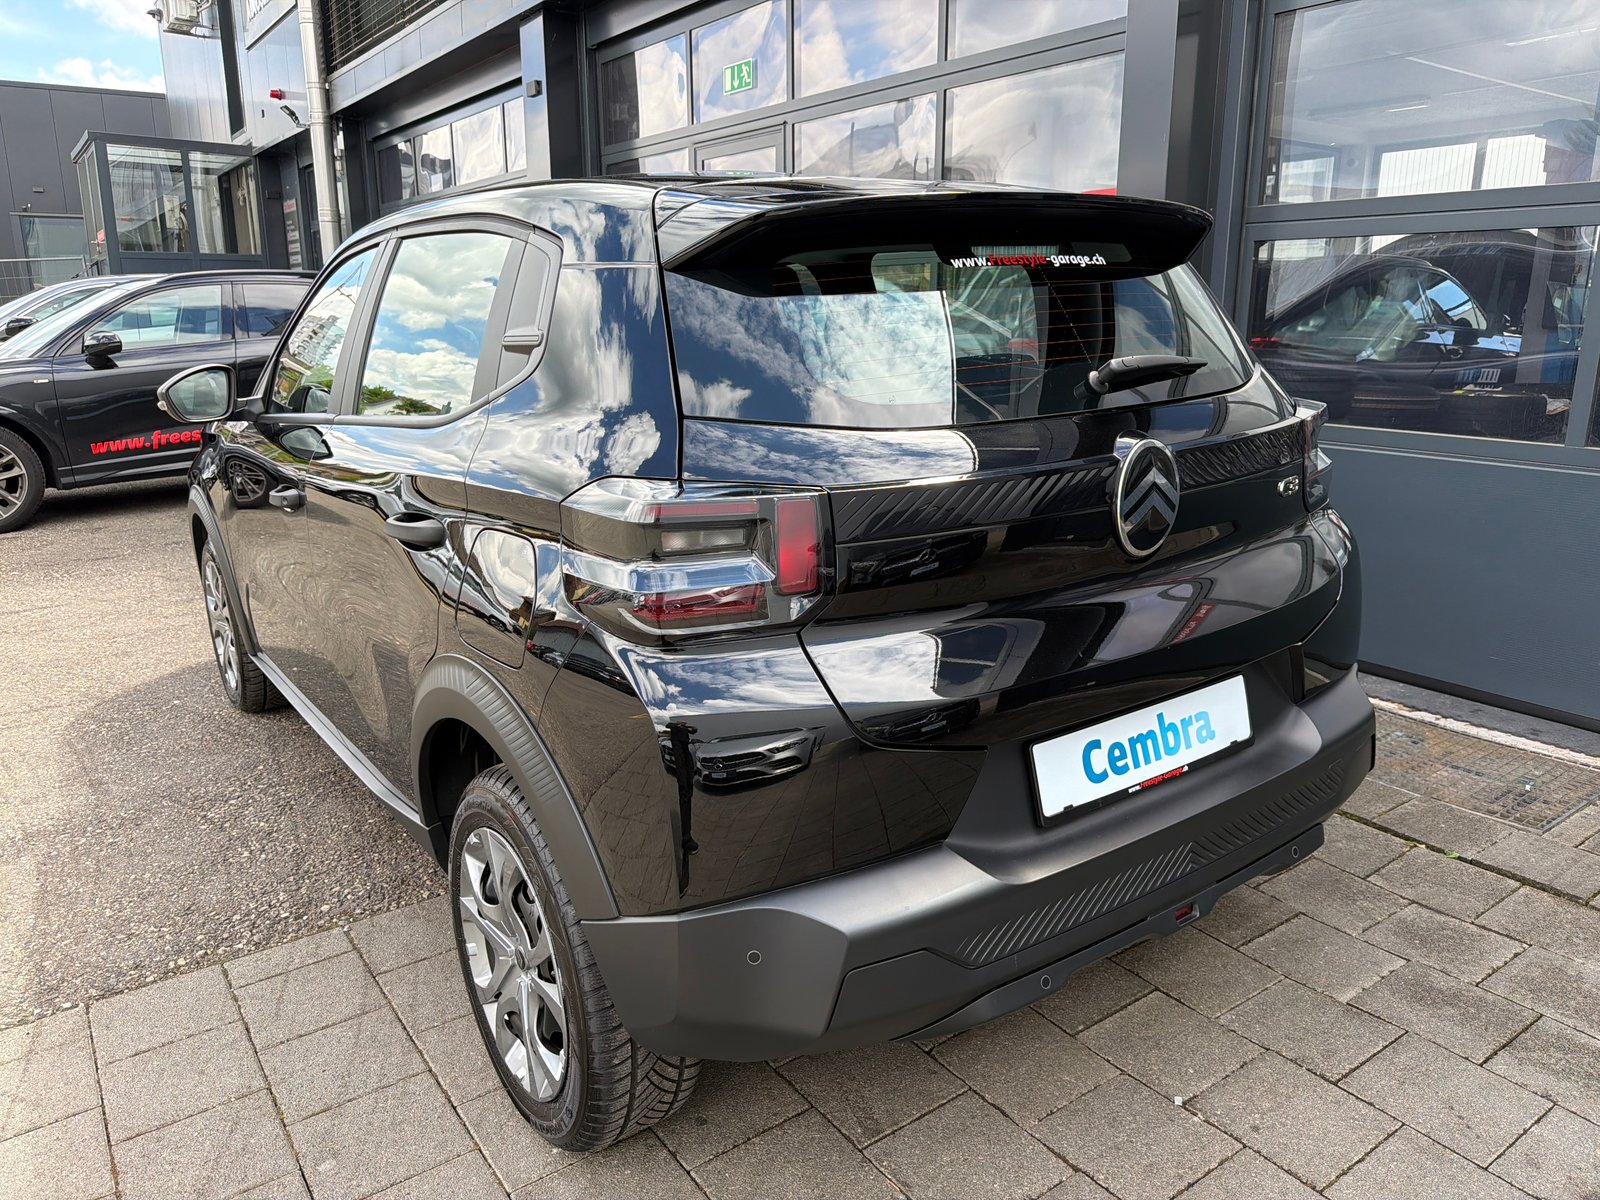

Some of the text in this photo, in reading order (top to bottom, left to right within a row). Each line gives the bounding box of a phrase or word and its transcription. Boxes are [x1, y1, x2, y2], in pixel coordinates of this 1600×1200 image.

[950, 252, 1107, 268] www.Freestyle-garage.ch
[90, 428, 204, 455] www.frees
[1082, 710, 1216, 784] Cembra
